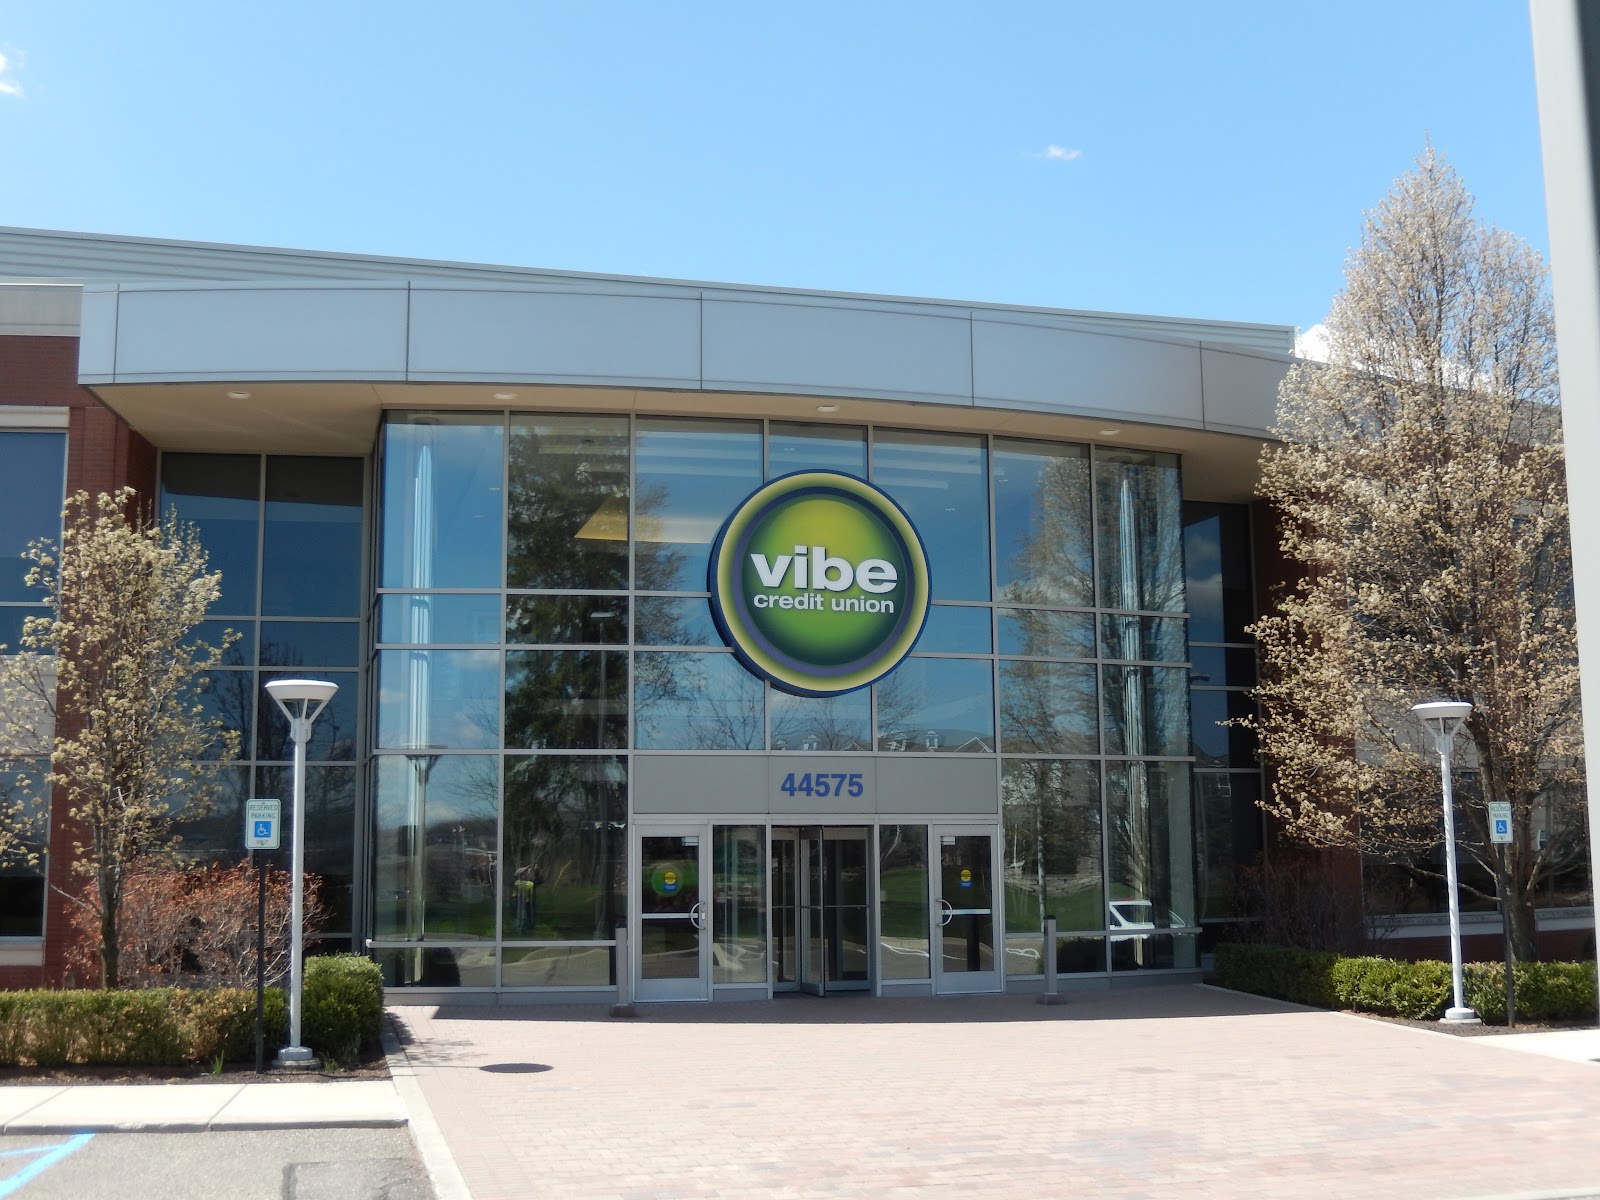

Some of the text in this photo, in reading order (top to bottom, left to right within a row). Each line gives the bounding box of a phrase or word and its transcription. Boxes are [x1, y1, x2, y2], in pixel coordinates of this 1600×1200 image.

[750, 545, 898, 593] vibe
[753, 593, 894, 614] credit union
[781, 772, 864, 797] 44575
